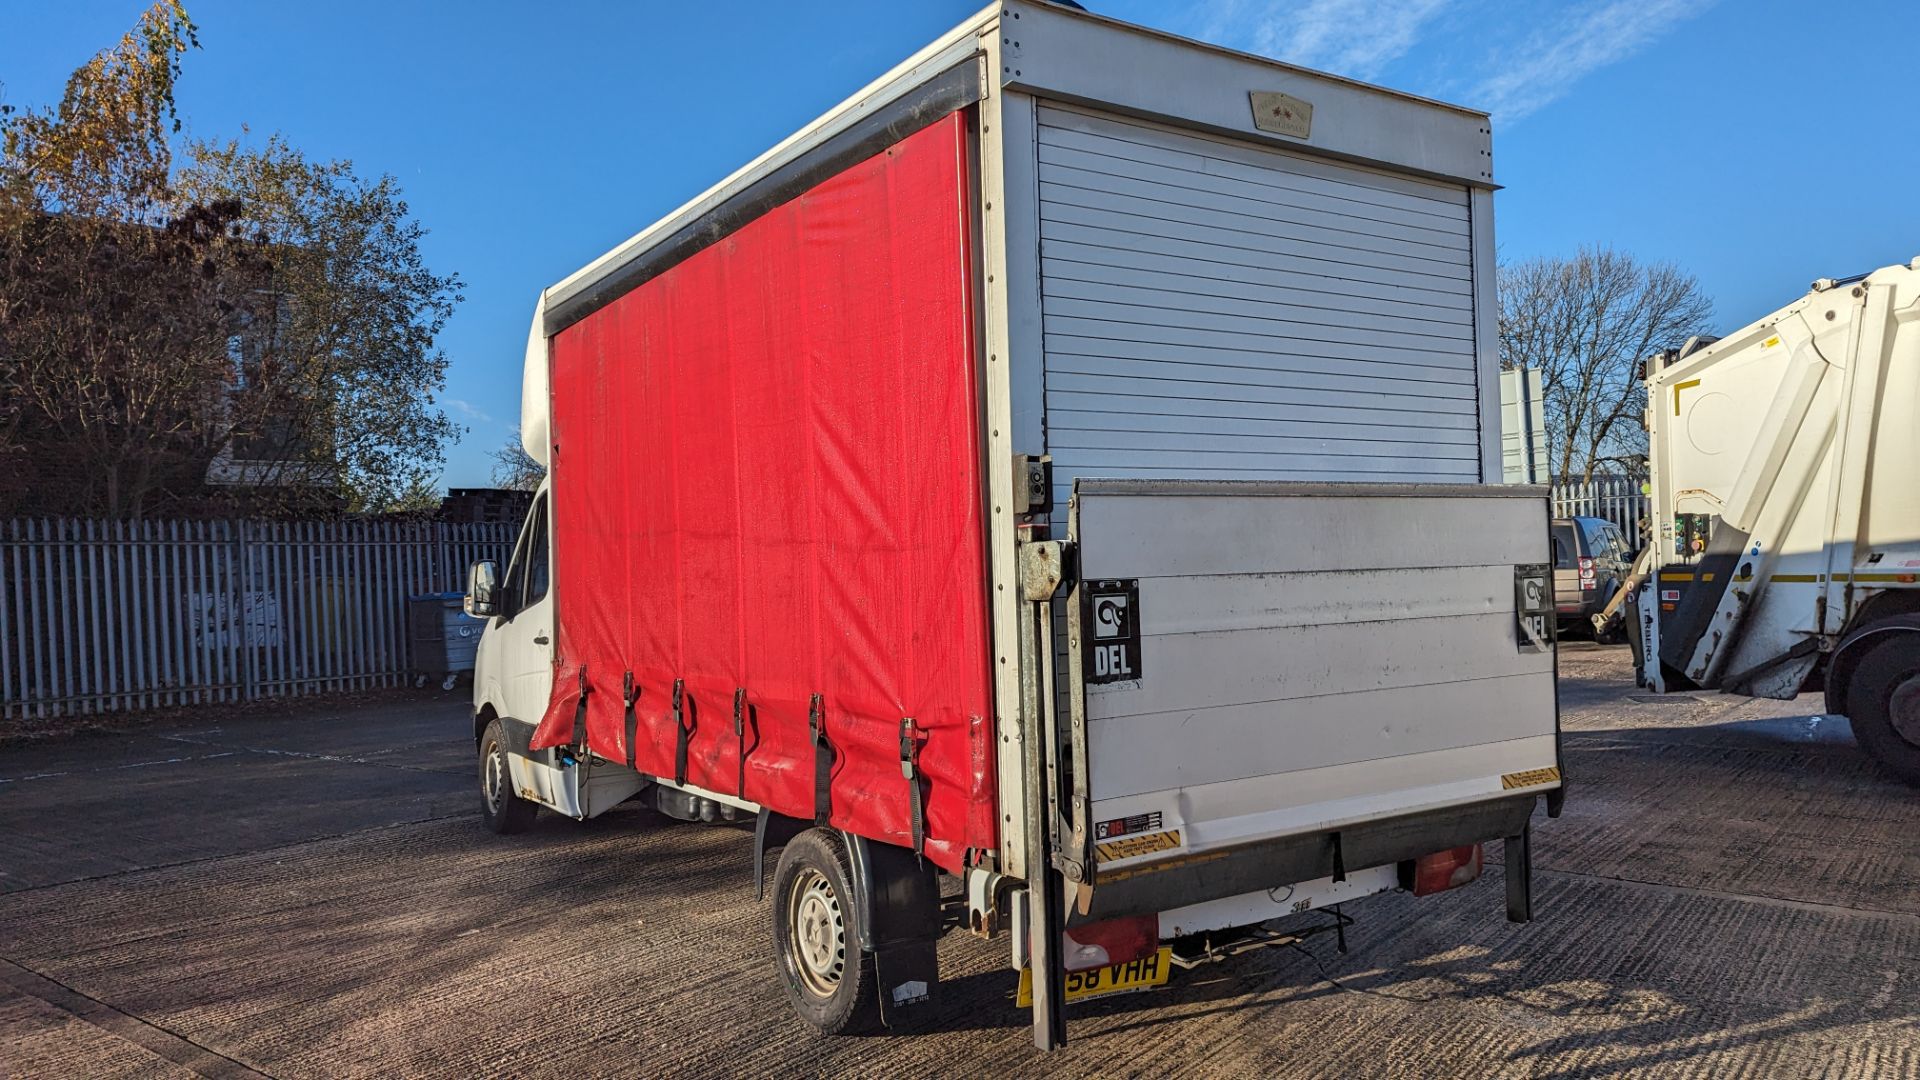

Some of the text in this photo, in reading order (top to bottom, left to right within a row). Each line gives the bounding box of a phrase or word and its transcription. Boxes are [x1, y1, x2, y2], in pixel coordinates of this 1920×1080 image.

[1525, 615, 1548, 640] DEL
[1095, 644, 1132, 676] DEL
[1110, 820, 1123, 835] DEL
[1067, 968, 1100, 993] 58
